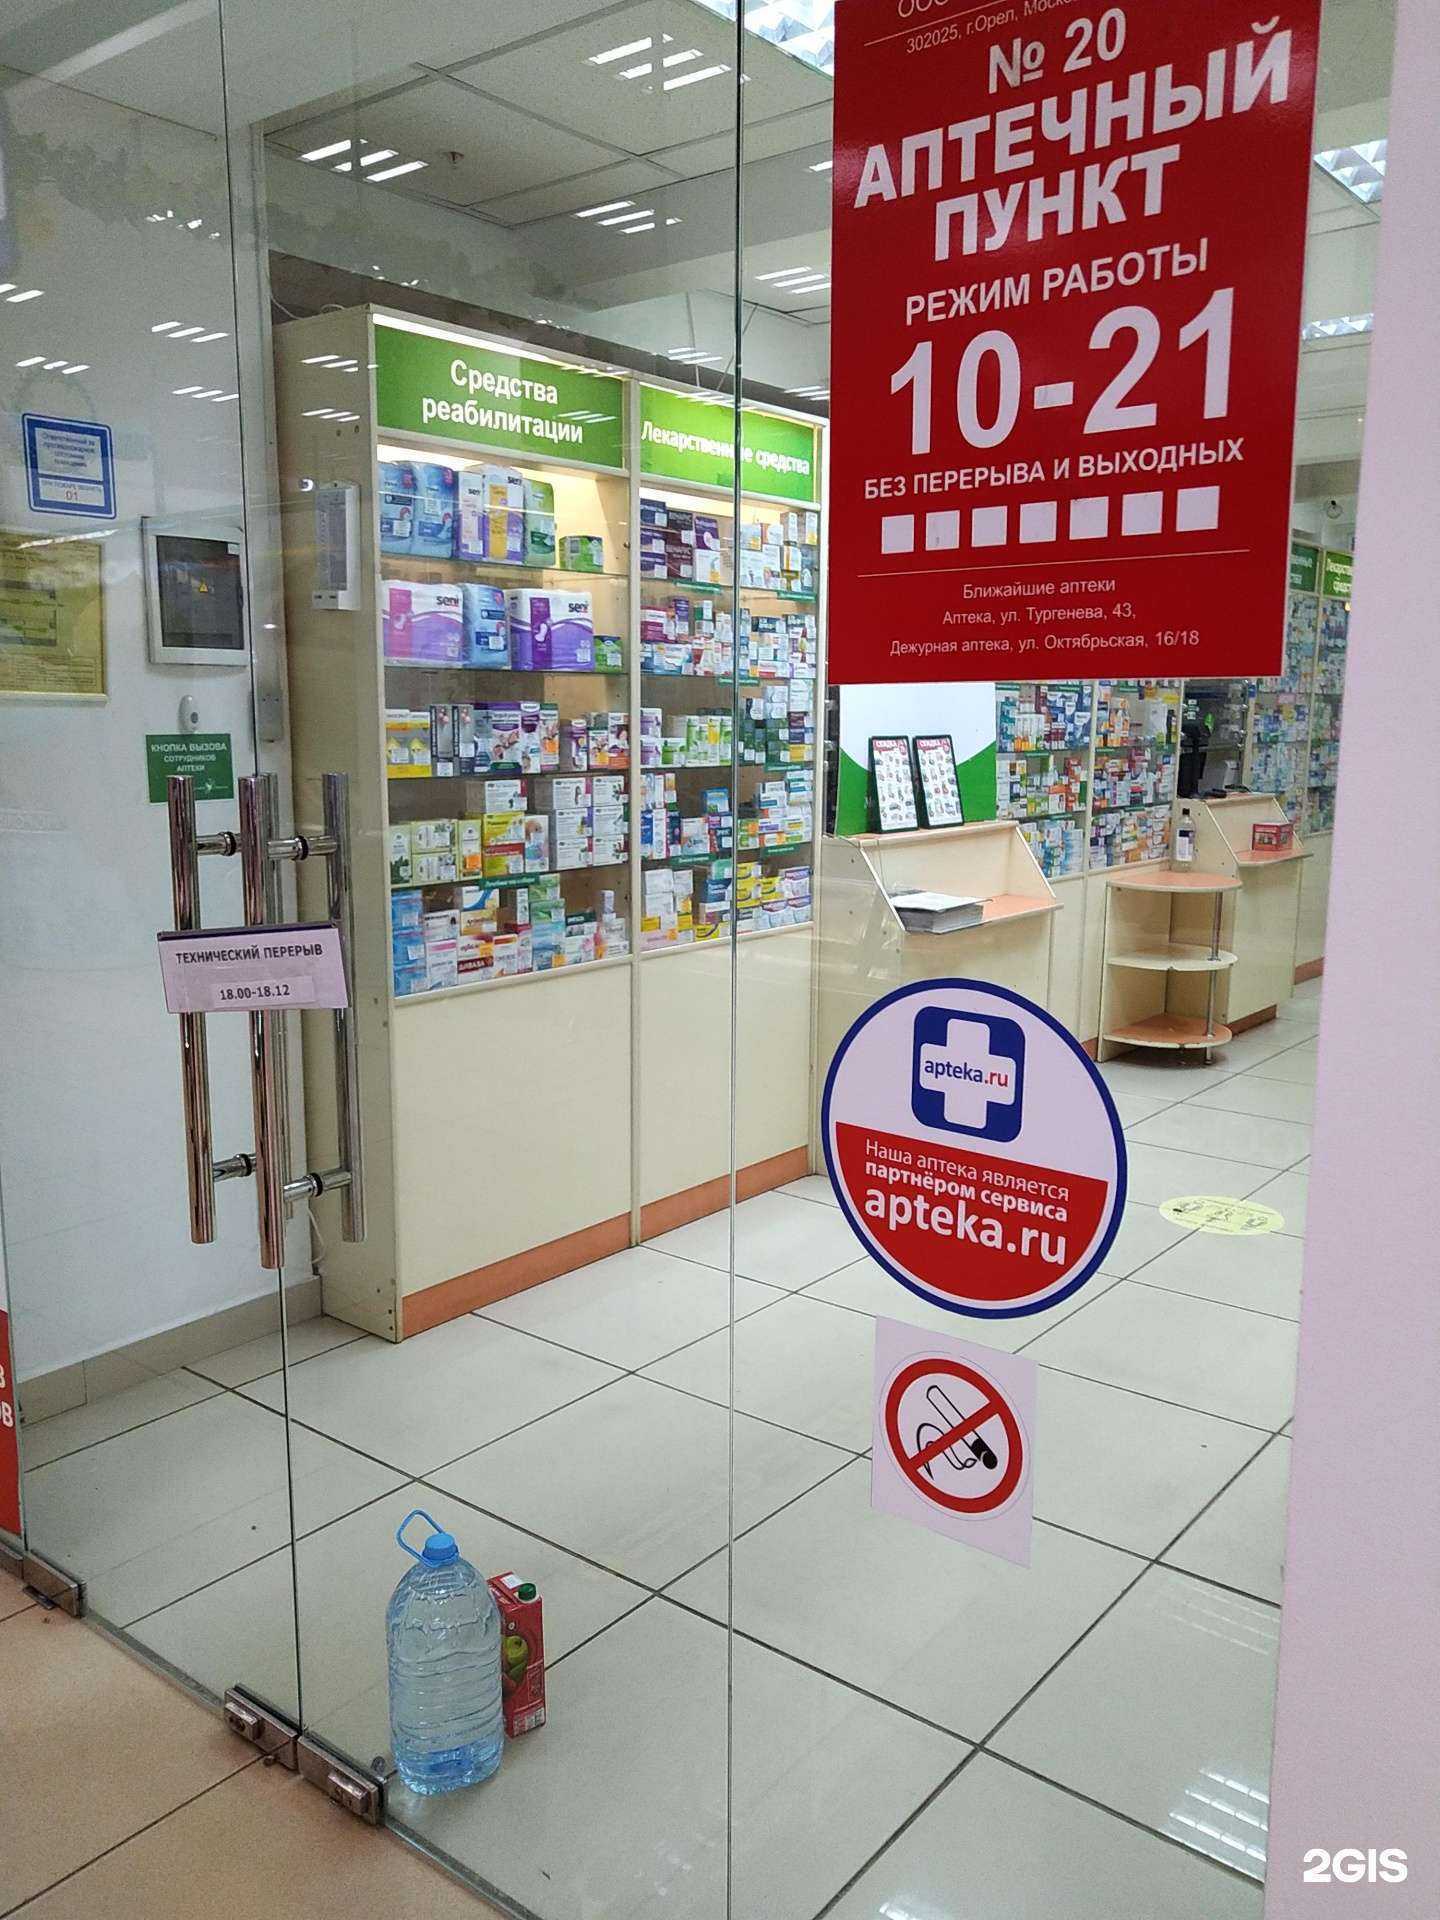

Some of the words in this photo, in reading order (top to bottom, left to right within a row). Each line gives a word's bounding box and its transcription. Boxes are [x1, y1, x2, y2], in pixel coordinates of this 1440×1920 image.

[906, 24, 962, 54] 302025,
[988, 38, 1045, 94] №
[1064, 8, 1126, 75] 20
[854, 15, 1293, 209] АПТЕЧНЫЙ
[935, 144, 1180, 262] ПУНКТ
[906, 272, 1030, 326] РЕЖИМ
[1042, 238, 1208, 301] РАБОТЫ
[450, 358, 558, 404] Средства
[890, 287, 1234, 455] 10-21
[422, 396, 583, 445] реабилитации
[756, 449, 810, 475] средства
[864, 476, 906, 500] БЕЗ
[914, 460, 1045, 494] ПЕРЕРЫВА
[1053, 457, 1069, 480] И
[1078, 437, 1245, 478] ВЫХОДНЫХ
[436, 594, 459, 606] seni
[963, 582, 1055, 599] Ближайшие
[1059, 579, 1115, 596] аптеки
[943, 610, 995, 625] Аптека,
[1000, 610, 1021, 626] ул.
[1026, 606, 1107, 624] Тургенева,
[1112, 602, 1136, 619] 43,
[890, 640, 957, 657] Дежурная
[962, 638, 1013, 654] аптека,
[1018, 638, 1039, 654] ул.
[1155, 630, 1200, 647] 16/18
[151, 743, 187, 752] КНОПКА
[189, 742, 227, 751] ВЫЗОВА
[176, 945, 261, 965] ТЕХНИЧЕСКИЙ
[264, 943, 323, 960] ПЕРЕРЫВ
[220, 984, 290, 1001] 18.00-18.12
[924, 1058, 1008, 1088] apteka.ru
[865, 1138, 912, 1166] Наша
[917, 1154, 977, 1182] аптека
[982, 1169, 1069, 1202] является
[865, 1161, 975, 1200] партнёром
[980, 1189, 1068, 1222] сервиса
[865, 1188, 1067, 1266] apteka.ru
